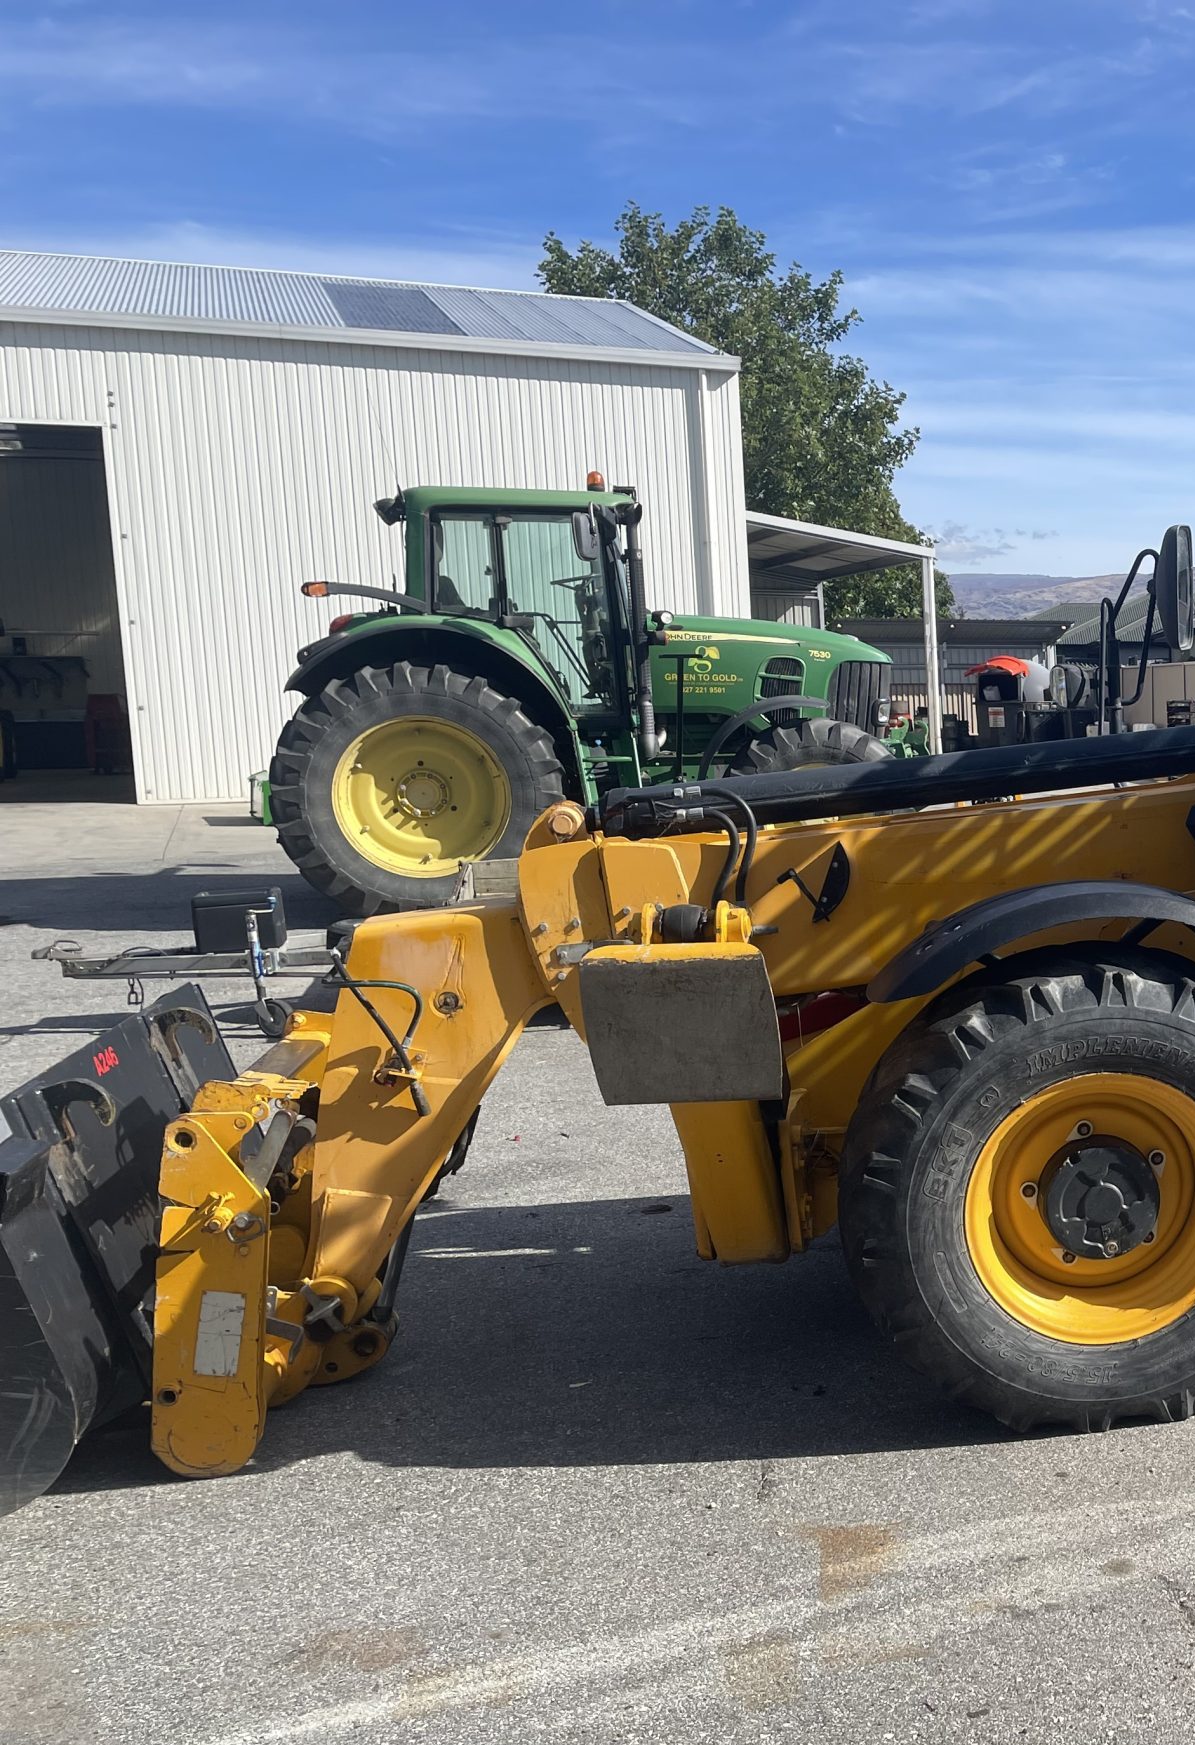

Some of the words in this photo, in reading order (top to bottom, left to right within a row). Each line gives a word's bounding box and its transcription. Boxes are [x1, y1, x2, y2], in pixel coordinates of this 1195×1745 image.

[808, 649, 831, 659] 7530
[664, 673, 696, 681] GREN
[711, 674, 737, 682] GOLD
[93, 1046, 119, 1077] A246
